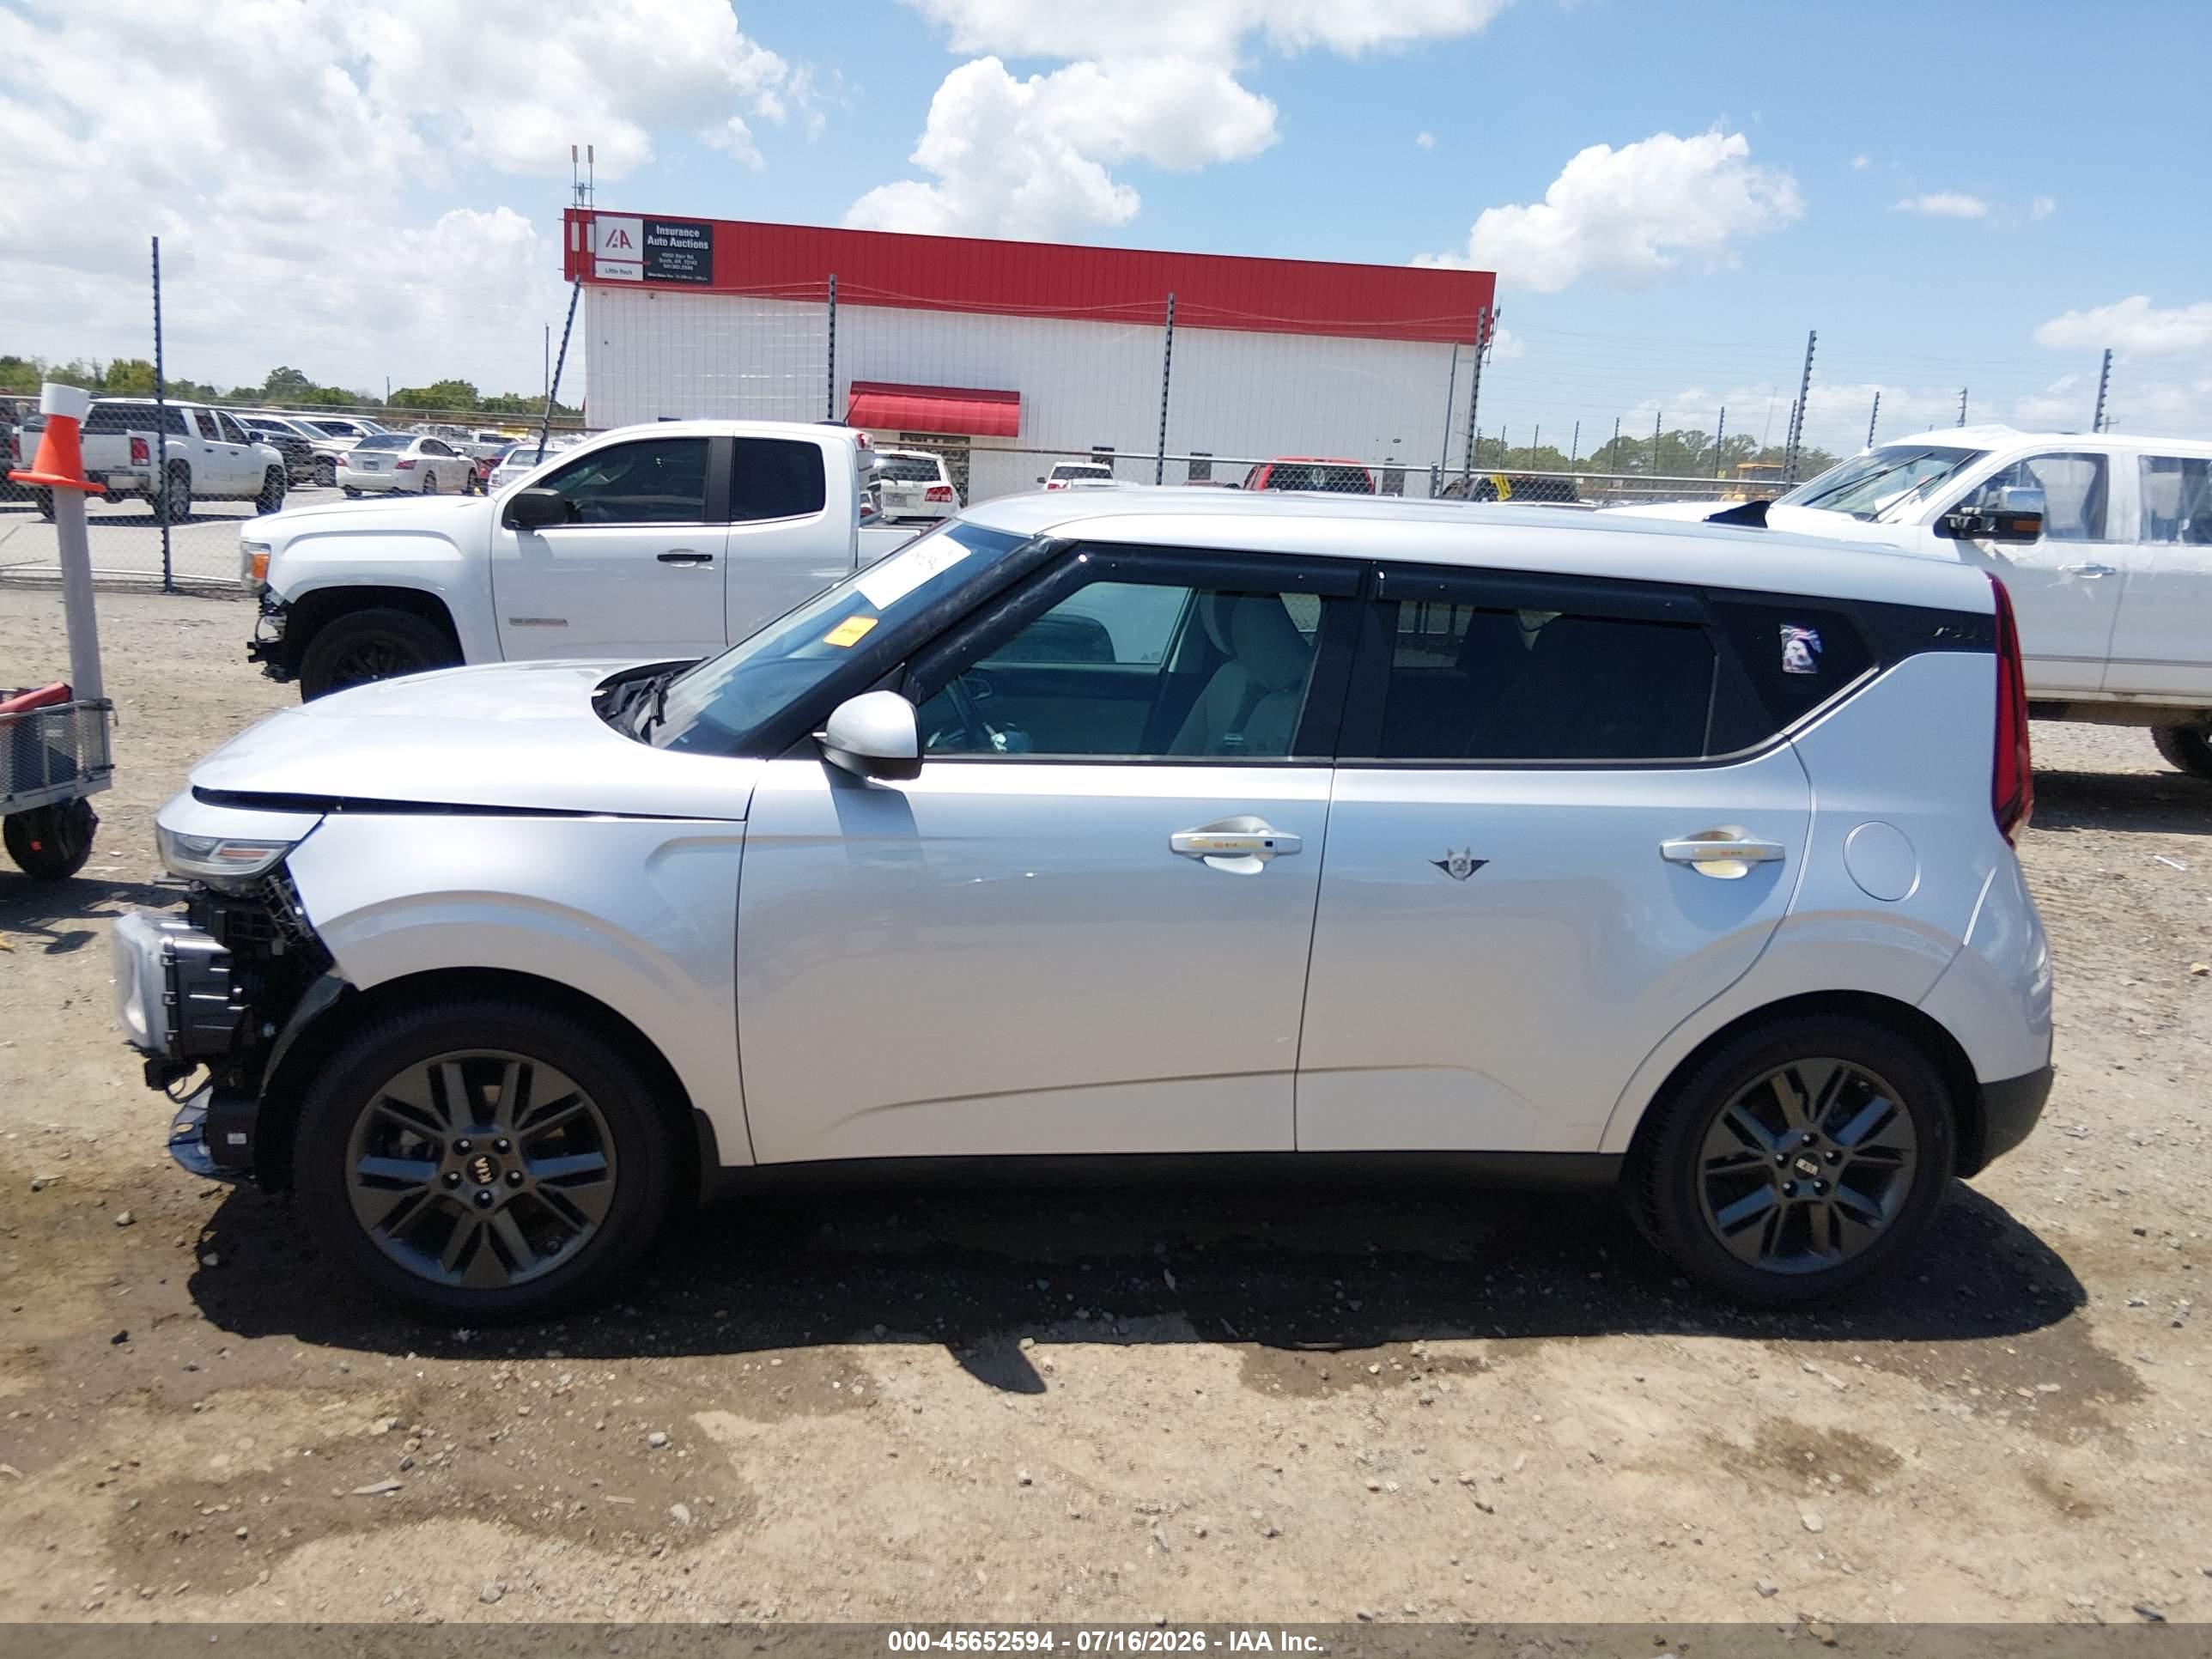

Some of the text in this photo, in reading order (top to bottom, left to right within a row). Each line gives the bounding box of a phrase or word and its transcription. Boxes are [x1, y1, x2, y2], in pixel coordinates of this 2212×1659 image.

[656, 224, 701, 238] Insurance
[647, 234, 709, 250] Auto Auctions
